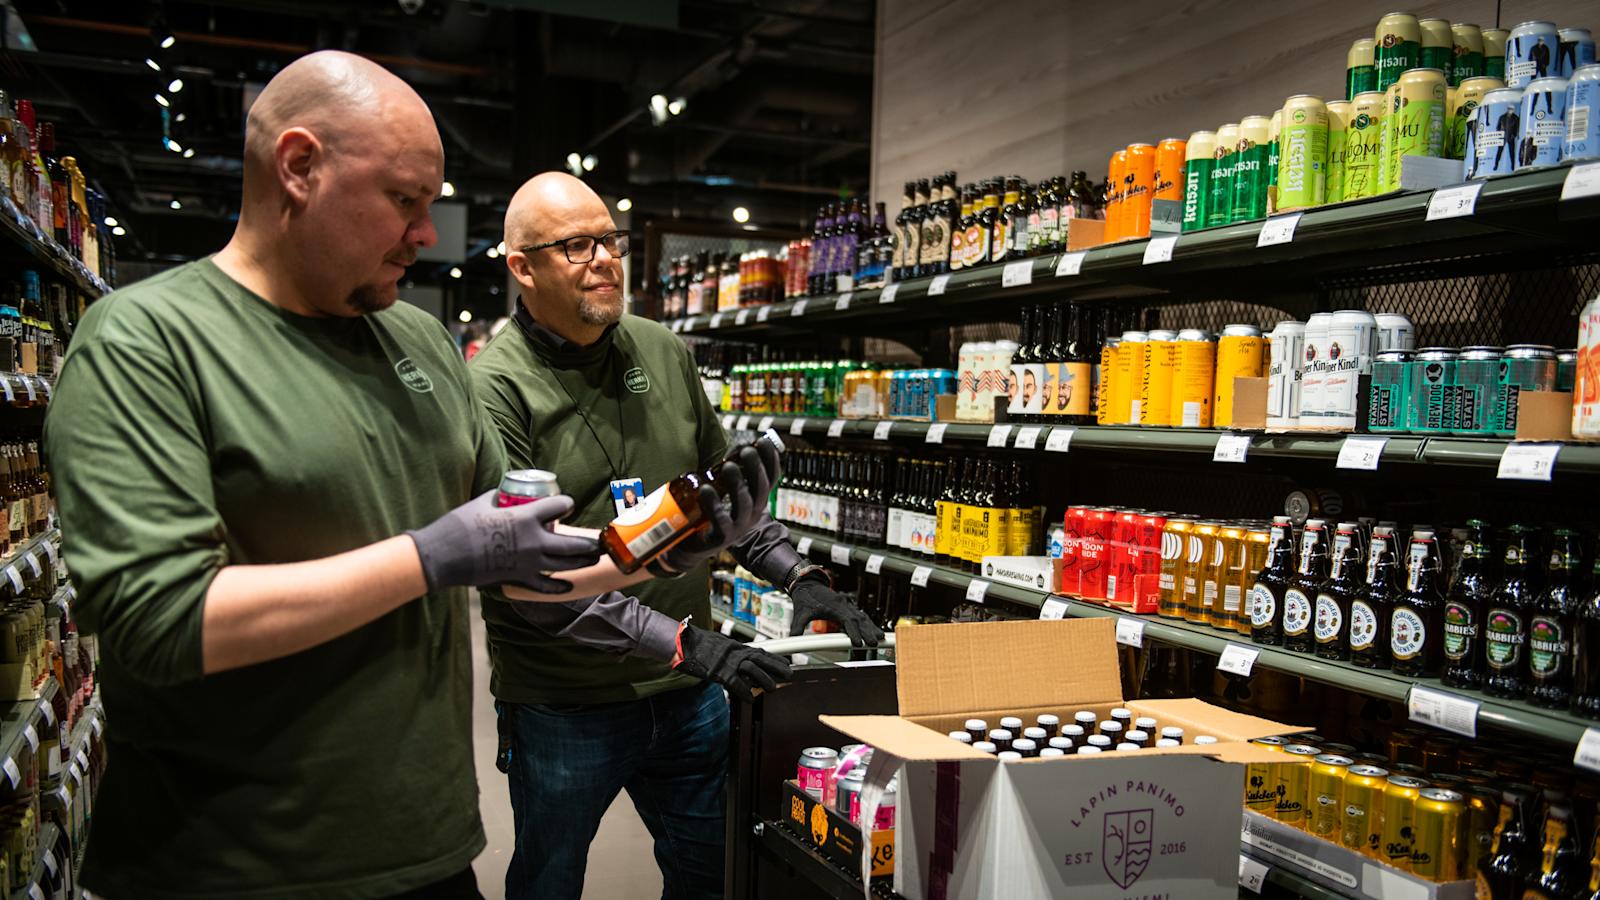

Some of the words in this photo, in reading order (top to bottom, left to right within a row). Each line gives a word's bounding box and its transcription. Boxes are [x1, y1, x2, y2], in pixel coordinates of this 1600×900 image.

[1184, 171, 1200, 223] keisari
[1371, 387, 1379, 426] NANNY
[1380, 390, 1389, 425] STATE
[1429, 384, 1442, 429] BREWDOG
[1454, 387, 1463, 428] NANNY
[1463, 389, 1474, 428] STATE
[1506, 387, 1519, 429] NANNY
[1070, 784, 1118, 828] LAPIN
[1126, 780, 1185, 817] PANIMO
[1064, 852, 1094, 866] EST
[1160, 841, 1187, 856] 2016
